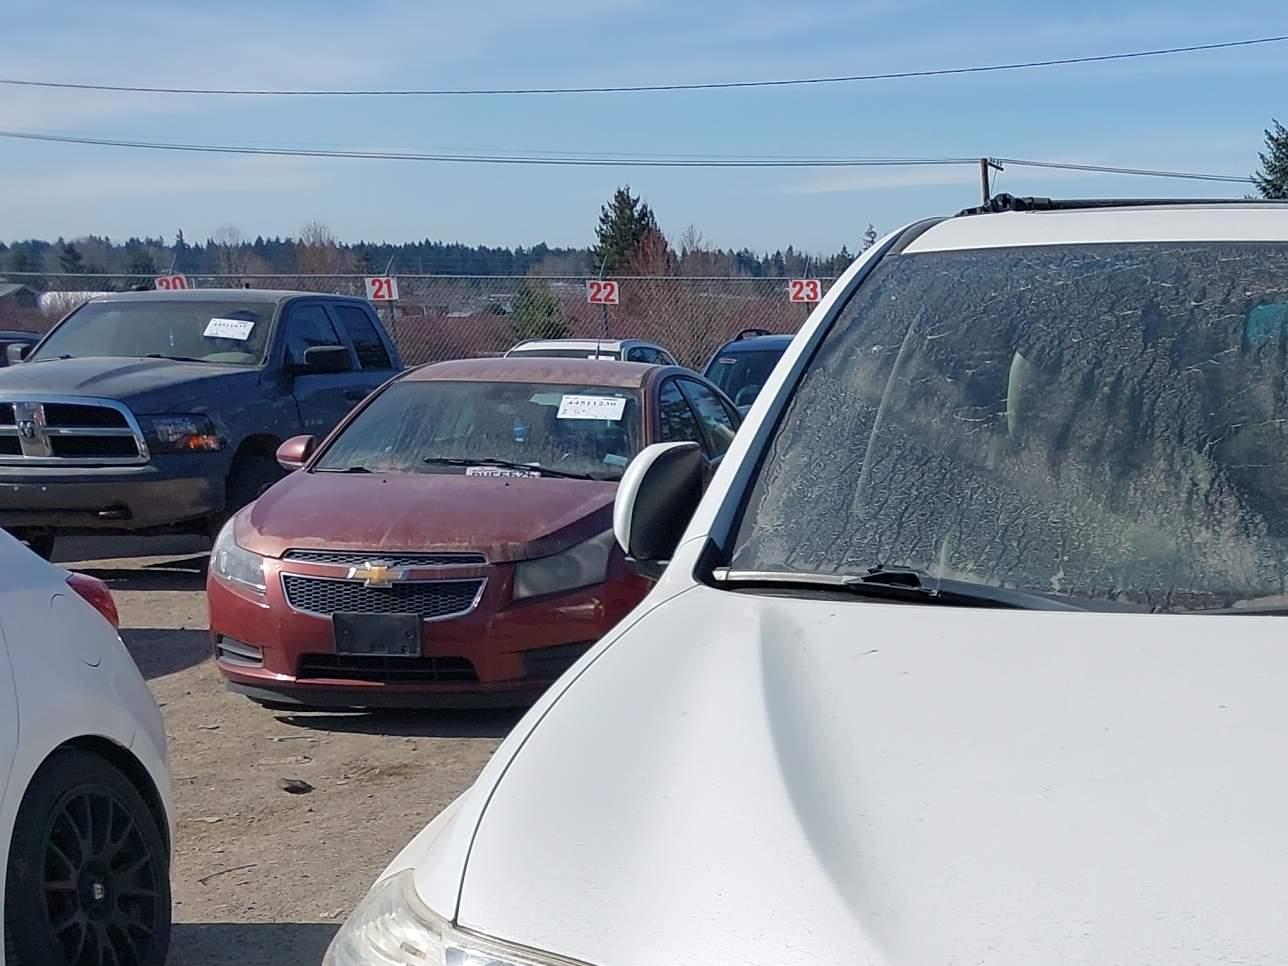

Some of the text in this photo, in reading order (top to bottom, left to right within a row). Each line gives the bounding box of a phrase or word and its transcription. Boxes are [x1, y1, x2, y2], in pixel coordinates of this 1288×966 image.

[371, 278, 394, 299] 21
[590, 282, 616, 302] 22
[792, 280, 818, 301] 23
